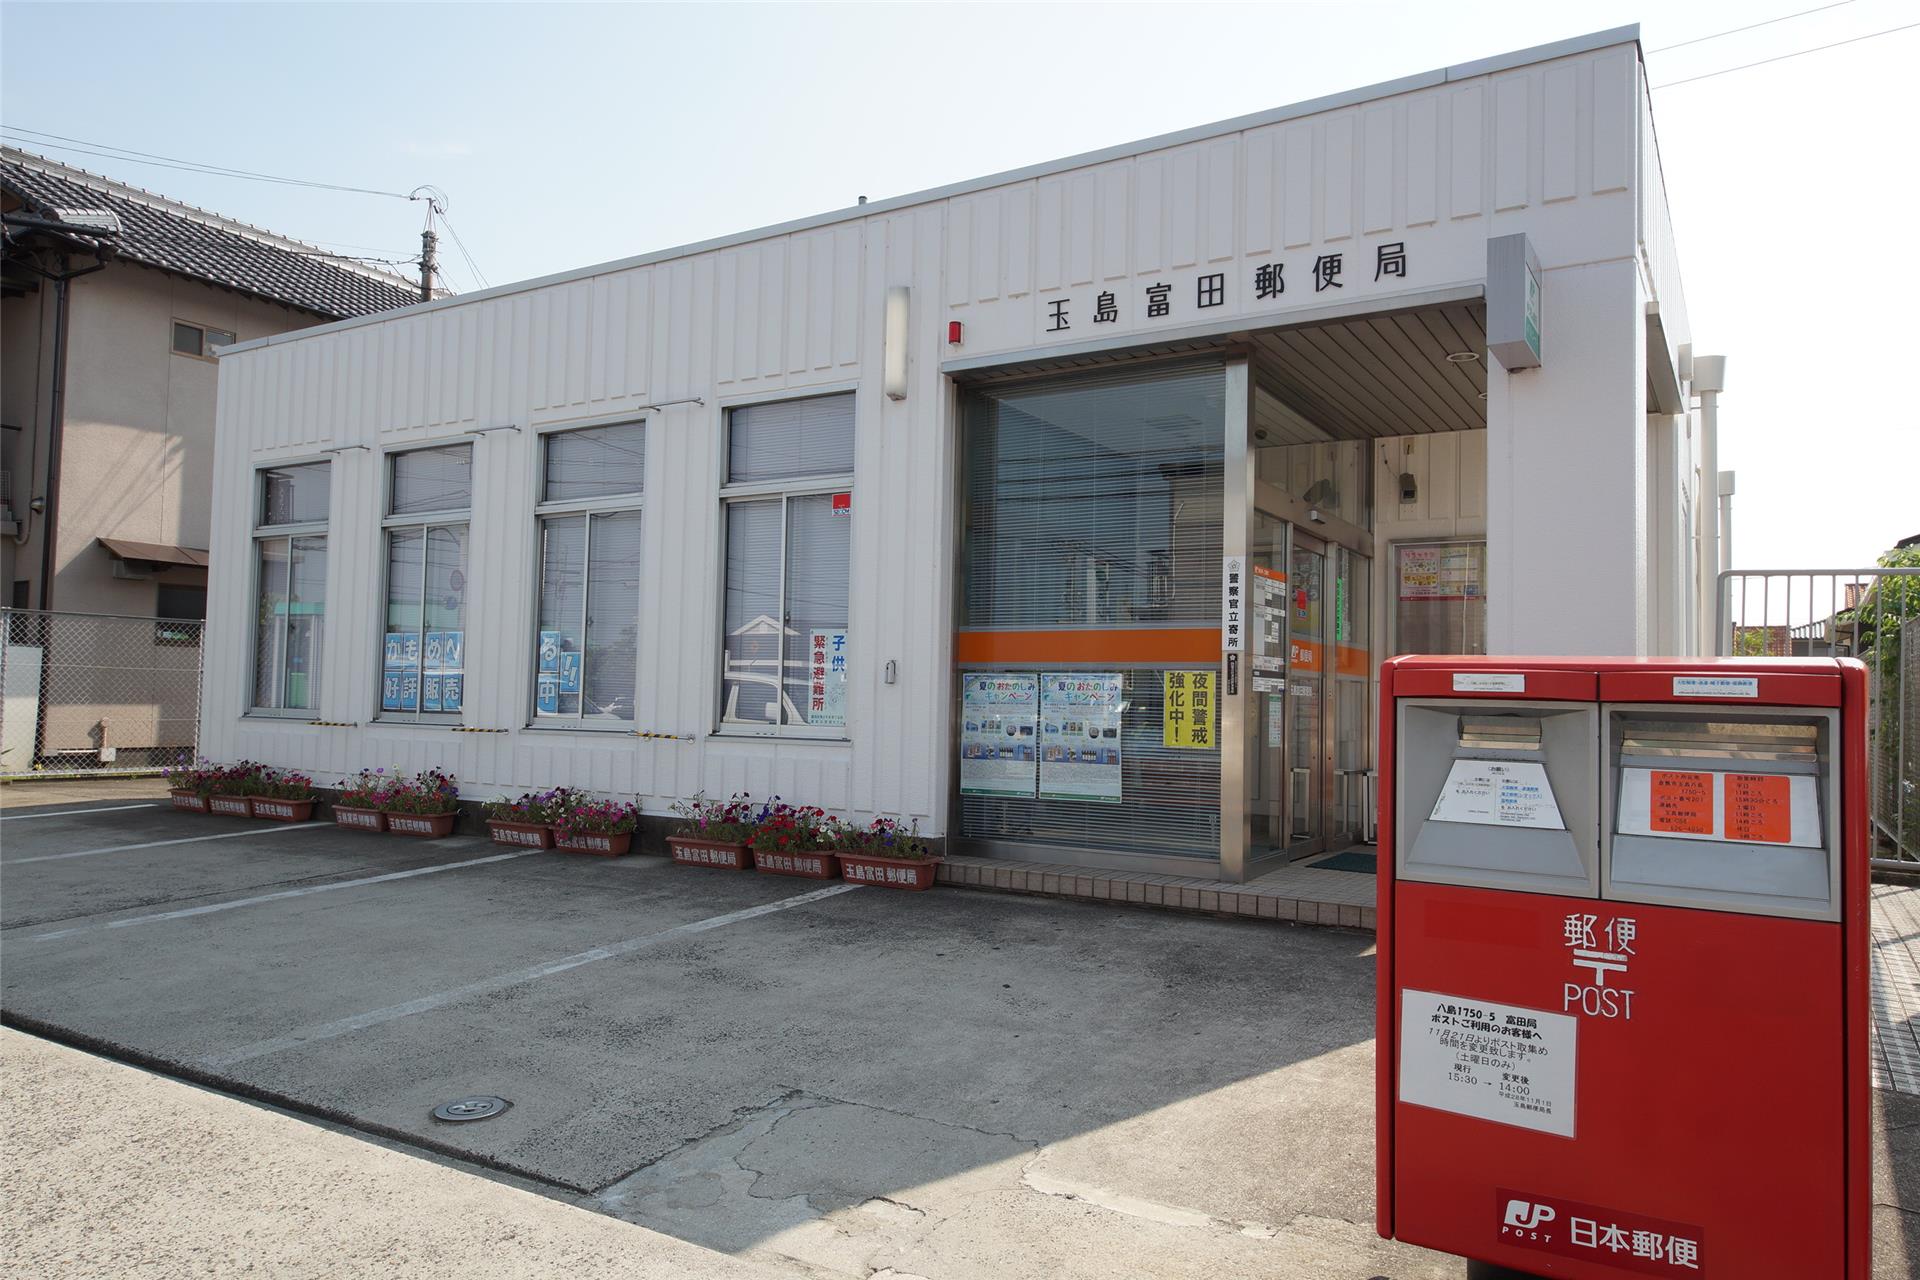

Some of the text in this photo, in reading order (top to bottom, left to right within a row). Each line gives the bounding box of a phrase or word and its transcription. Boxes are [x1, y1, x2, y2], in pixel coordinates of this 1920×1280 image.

[1046, 242, 1406, 332] 玉島富田郵便局
[1228, 573, 1239, 647] 警察官立寄所
[832, 635, 845, 672] 子供
[812, 635, 825, 711] 緊急避難所
[385, 677, 555, 703] 好評販売 中
[980, 682, 1035, 692] 夏のおたのしみ
[985, 691, 1032, 701] キャンペーン
[1058, 682, 1118, 692] 夏のおたのしみ
[1064, 692, 1115, 702] キャンペーン
[1192, 672, 1208, 744] 夜間警戒
[675, 845, 737, 866] 玉島富田郵便局
[757, 853, 822, 874] 玉島富田郵便局
[846, 863, 917, 885] 玉島富田郵便局
[1564, 913, 1636, 955] 郵便
[1564, 983, 1635, 1020] POST
[1431, 1014, 1543, 1041] ポストご利用のお客様へ
[1436, 1003, 1537, 1030] 八島1750-5 富田局
[1428, 1027, 1549, 1056] 11月21日よりポスト取集め
[1439, 1038, 1532, 1063] 時間を変更致します。
[1453, 1063, 1471, 1074] 現行
[1502, 1072, 1530, 1086] 変更後
[1448, 1072, 1531, 1096] 15:30 14:00
[1513, 1101, 1552, 1115] 玉島郵便局長
[1502, 1227, 1552, 1243] POST
[1570, 1216, 1699, 1270] 日本郵便
